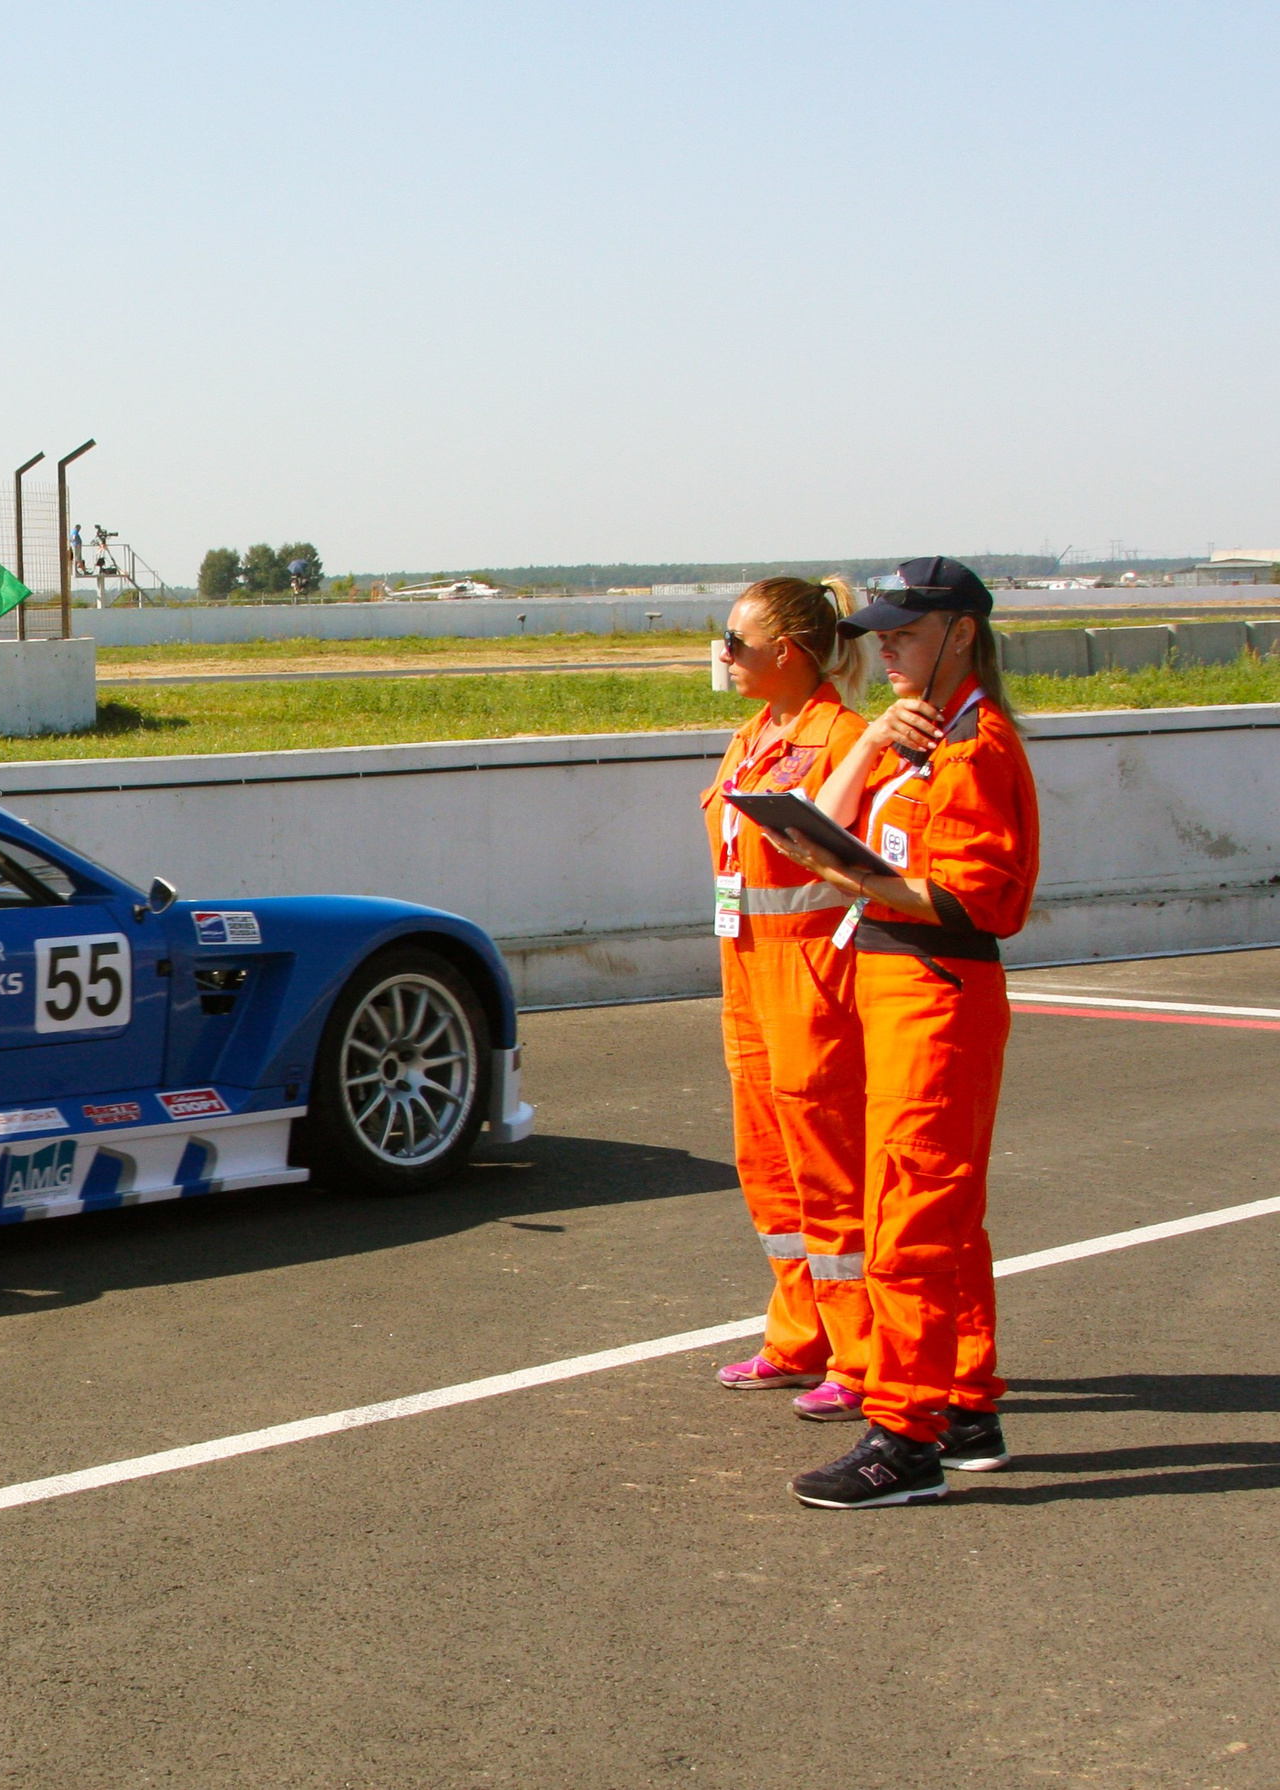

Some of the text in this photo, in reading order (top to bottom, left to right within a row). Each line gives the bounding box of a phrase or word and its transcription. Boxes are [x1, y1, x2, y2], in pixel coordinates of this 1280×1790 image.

[44, 942, 122, 1021] 55
[171, 1101, 221, 1114] СПОРТ
[8, 1163, 72, 1194] AMG
